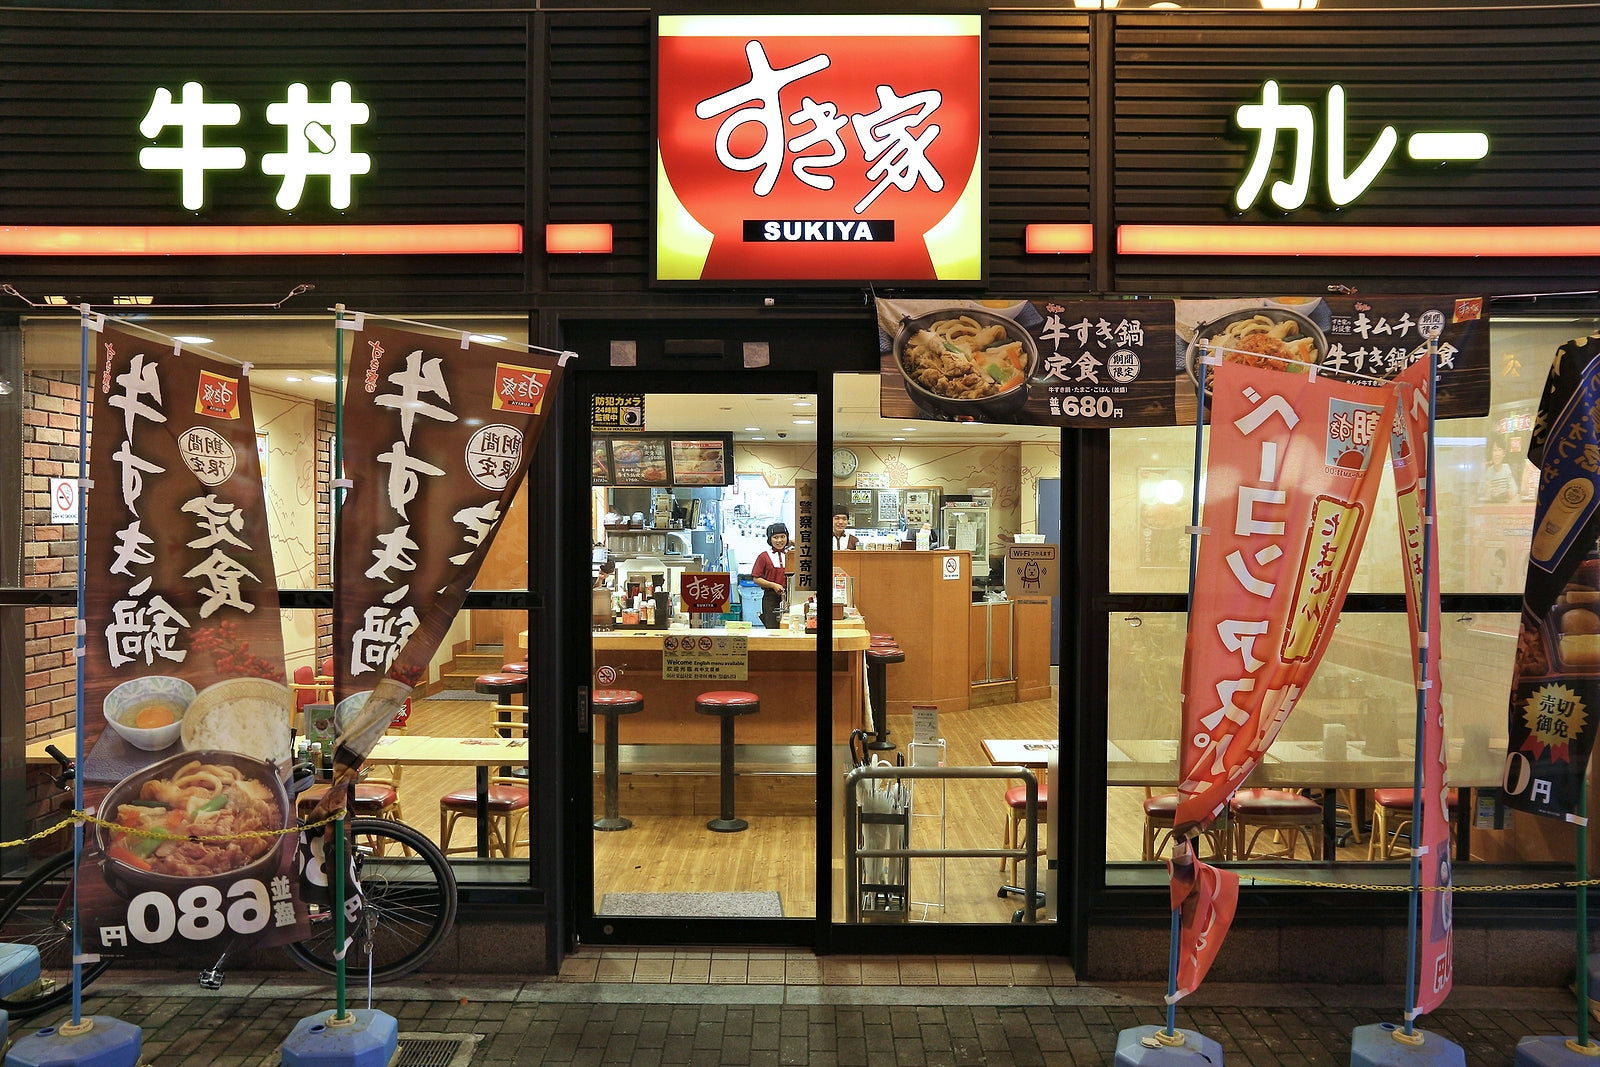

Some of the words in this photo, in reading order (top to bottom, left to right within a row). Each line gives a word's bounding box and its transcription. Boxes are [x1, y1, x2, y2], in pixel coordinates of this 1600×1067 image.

[695, 39, 945, 214] すき家
[139, 81, 371, 210] 牛丼
[1236, 79, 1489, 210] カレー
[763, 222, 873, 240] SUKIYA
[1038, 315, 1145, 350] 牛すき鍋
[1353, 313, 1416, 339] キムチ
[1043, 351, 1104, 384] 定食
[1112, 354, 1134, 365] 期間
[1112, 366, 1136, 378] 限定
[595, 396, 641, 406] 防犯カメラ
[798, 500, 813, 587] 警察官立寄所
[686, 576, 725, 602] すき家
[1539, 695, 1575, 717] 売切
[1536, 714, 1569, 739] 御免
